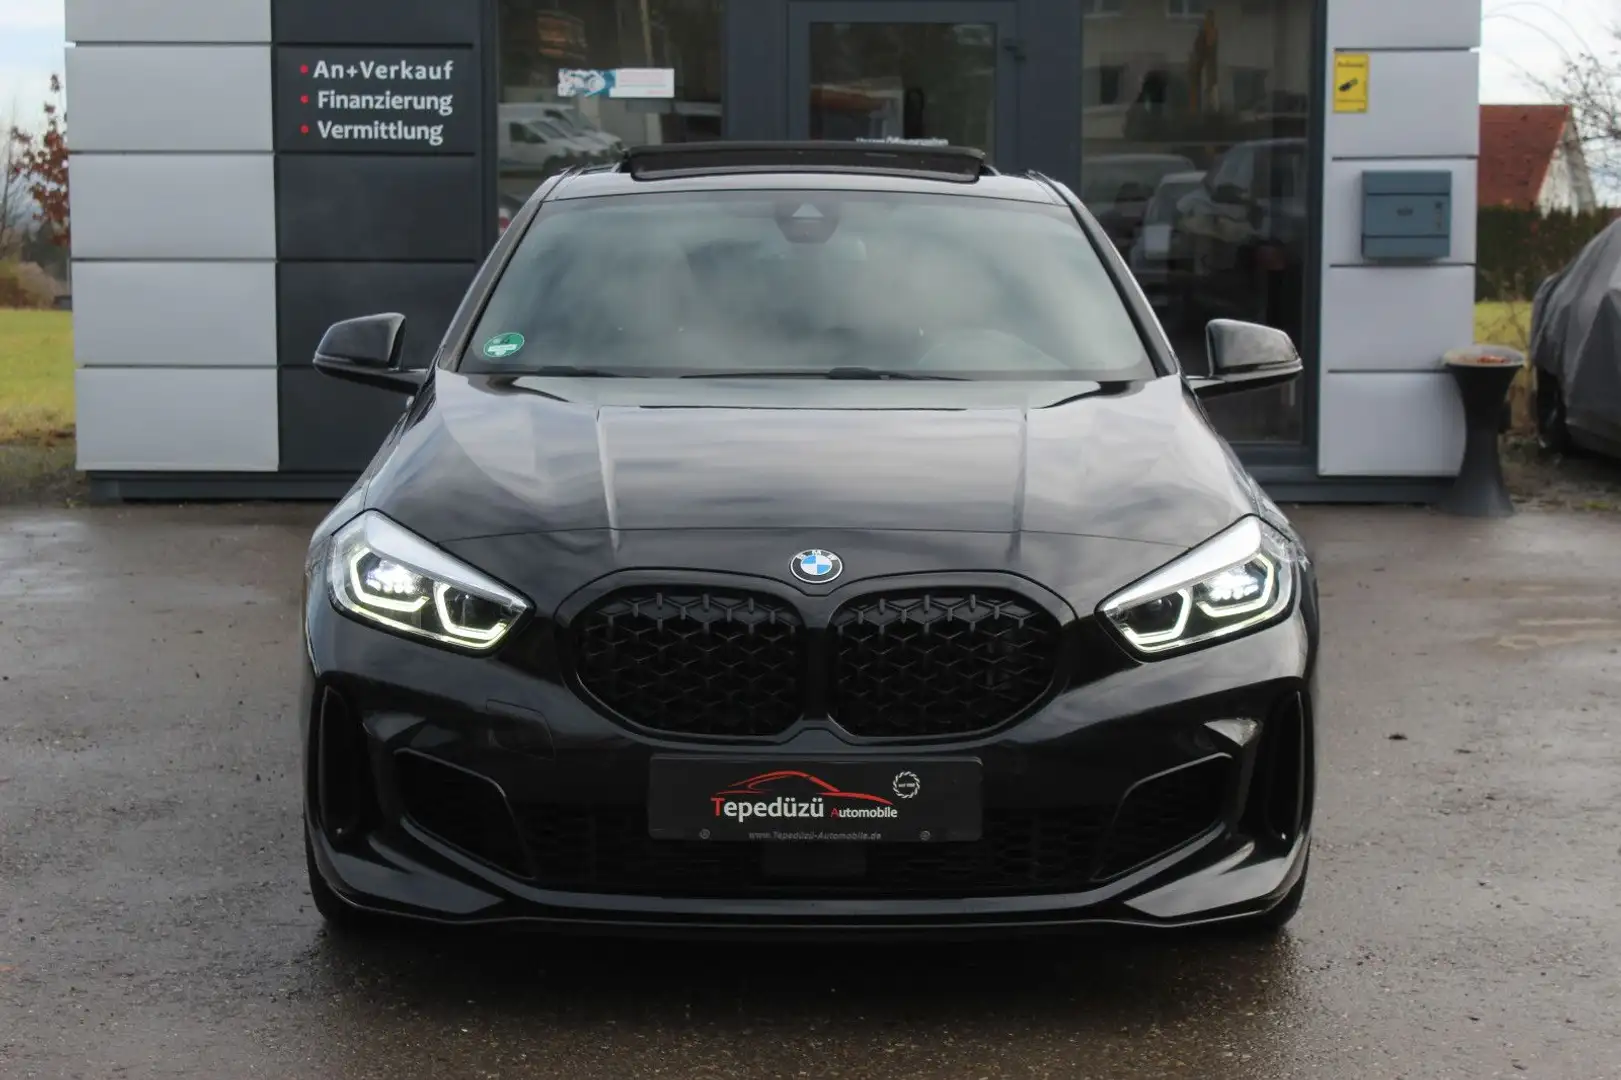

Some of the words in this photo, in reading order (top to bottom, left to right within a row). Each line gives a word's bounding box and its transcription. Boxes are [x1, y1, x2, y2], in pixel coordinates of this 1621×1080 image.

[313, 60, 454, 80] An+Verkauf
[318, 90, 453, 116] Finanzierung
[317, 120, 444, 146] Vermittlung
[796, 549, 839, 561] BMW
[710, 797, 824, 822] Tepedüzü
[830, 806, 898, 818] Automobile
